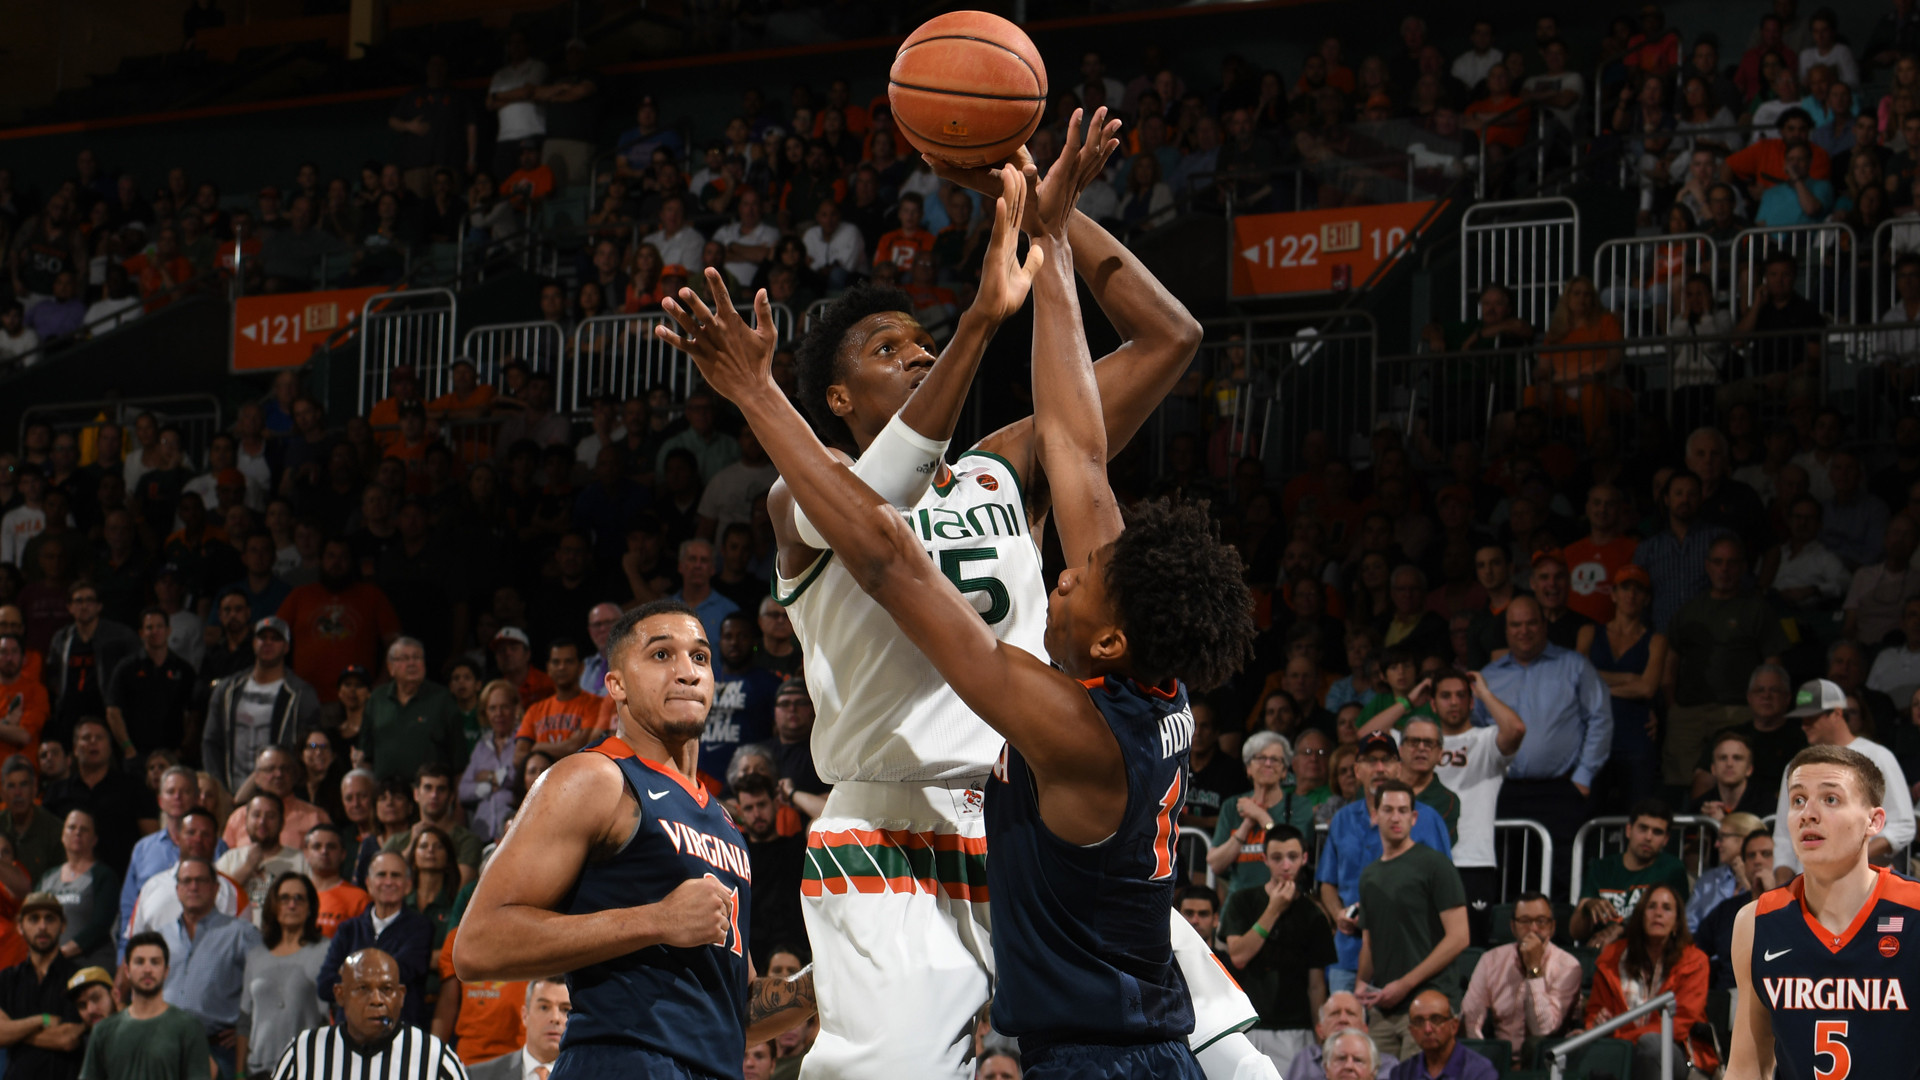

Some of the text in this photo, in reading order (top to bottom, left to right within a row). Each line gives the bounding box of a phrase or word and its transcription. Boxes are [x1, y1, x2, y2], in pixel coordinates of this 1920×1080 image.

[1264, 233, 1319, 269] 122
[1327, 223, 1354, 248] EXIT
[260, 313, 301, 346] 121
[928, 546, 1011, 626] 5
[1148, 764, 1189, 881] 1
[658, 818, 752, 888] VIRGINIA
[1763, 977, 1909, 1012] VIRGINIA
[1813, 1020, 1852, 1080] 5
